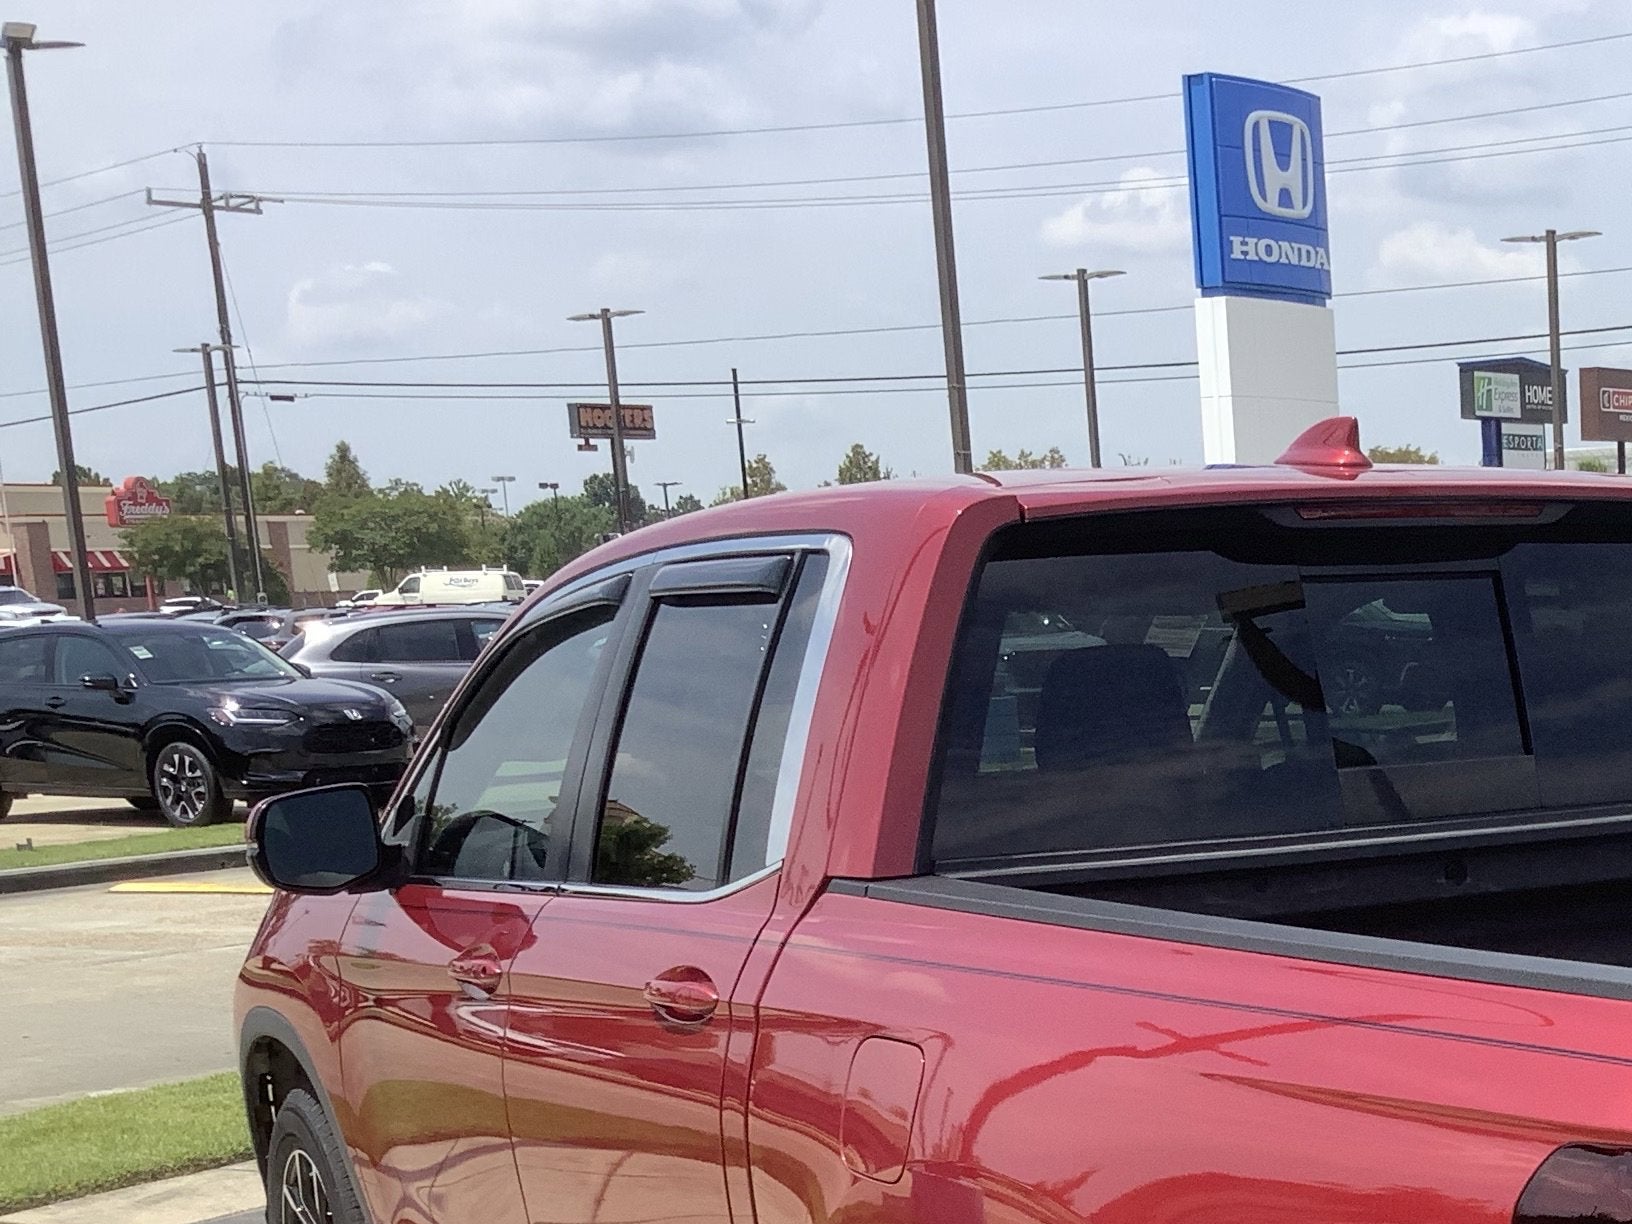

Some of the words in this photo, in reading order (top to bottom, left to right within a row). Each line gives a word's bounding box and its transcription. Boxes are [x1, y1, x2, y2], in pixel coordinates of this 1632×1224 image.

[1229, 235, 1330, 270] HONDA
[1525, 385, 1554, 404] HOME
[1502, 435, 1543, 451] ESPORTA
[120, 500, 170, 516] Freddy's
